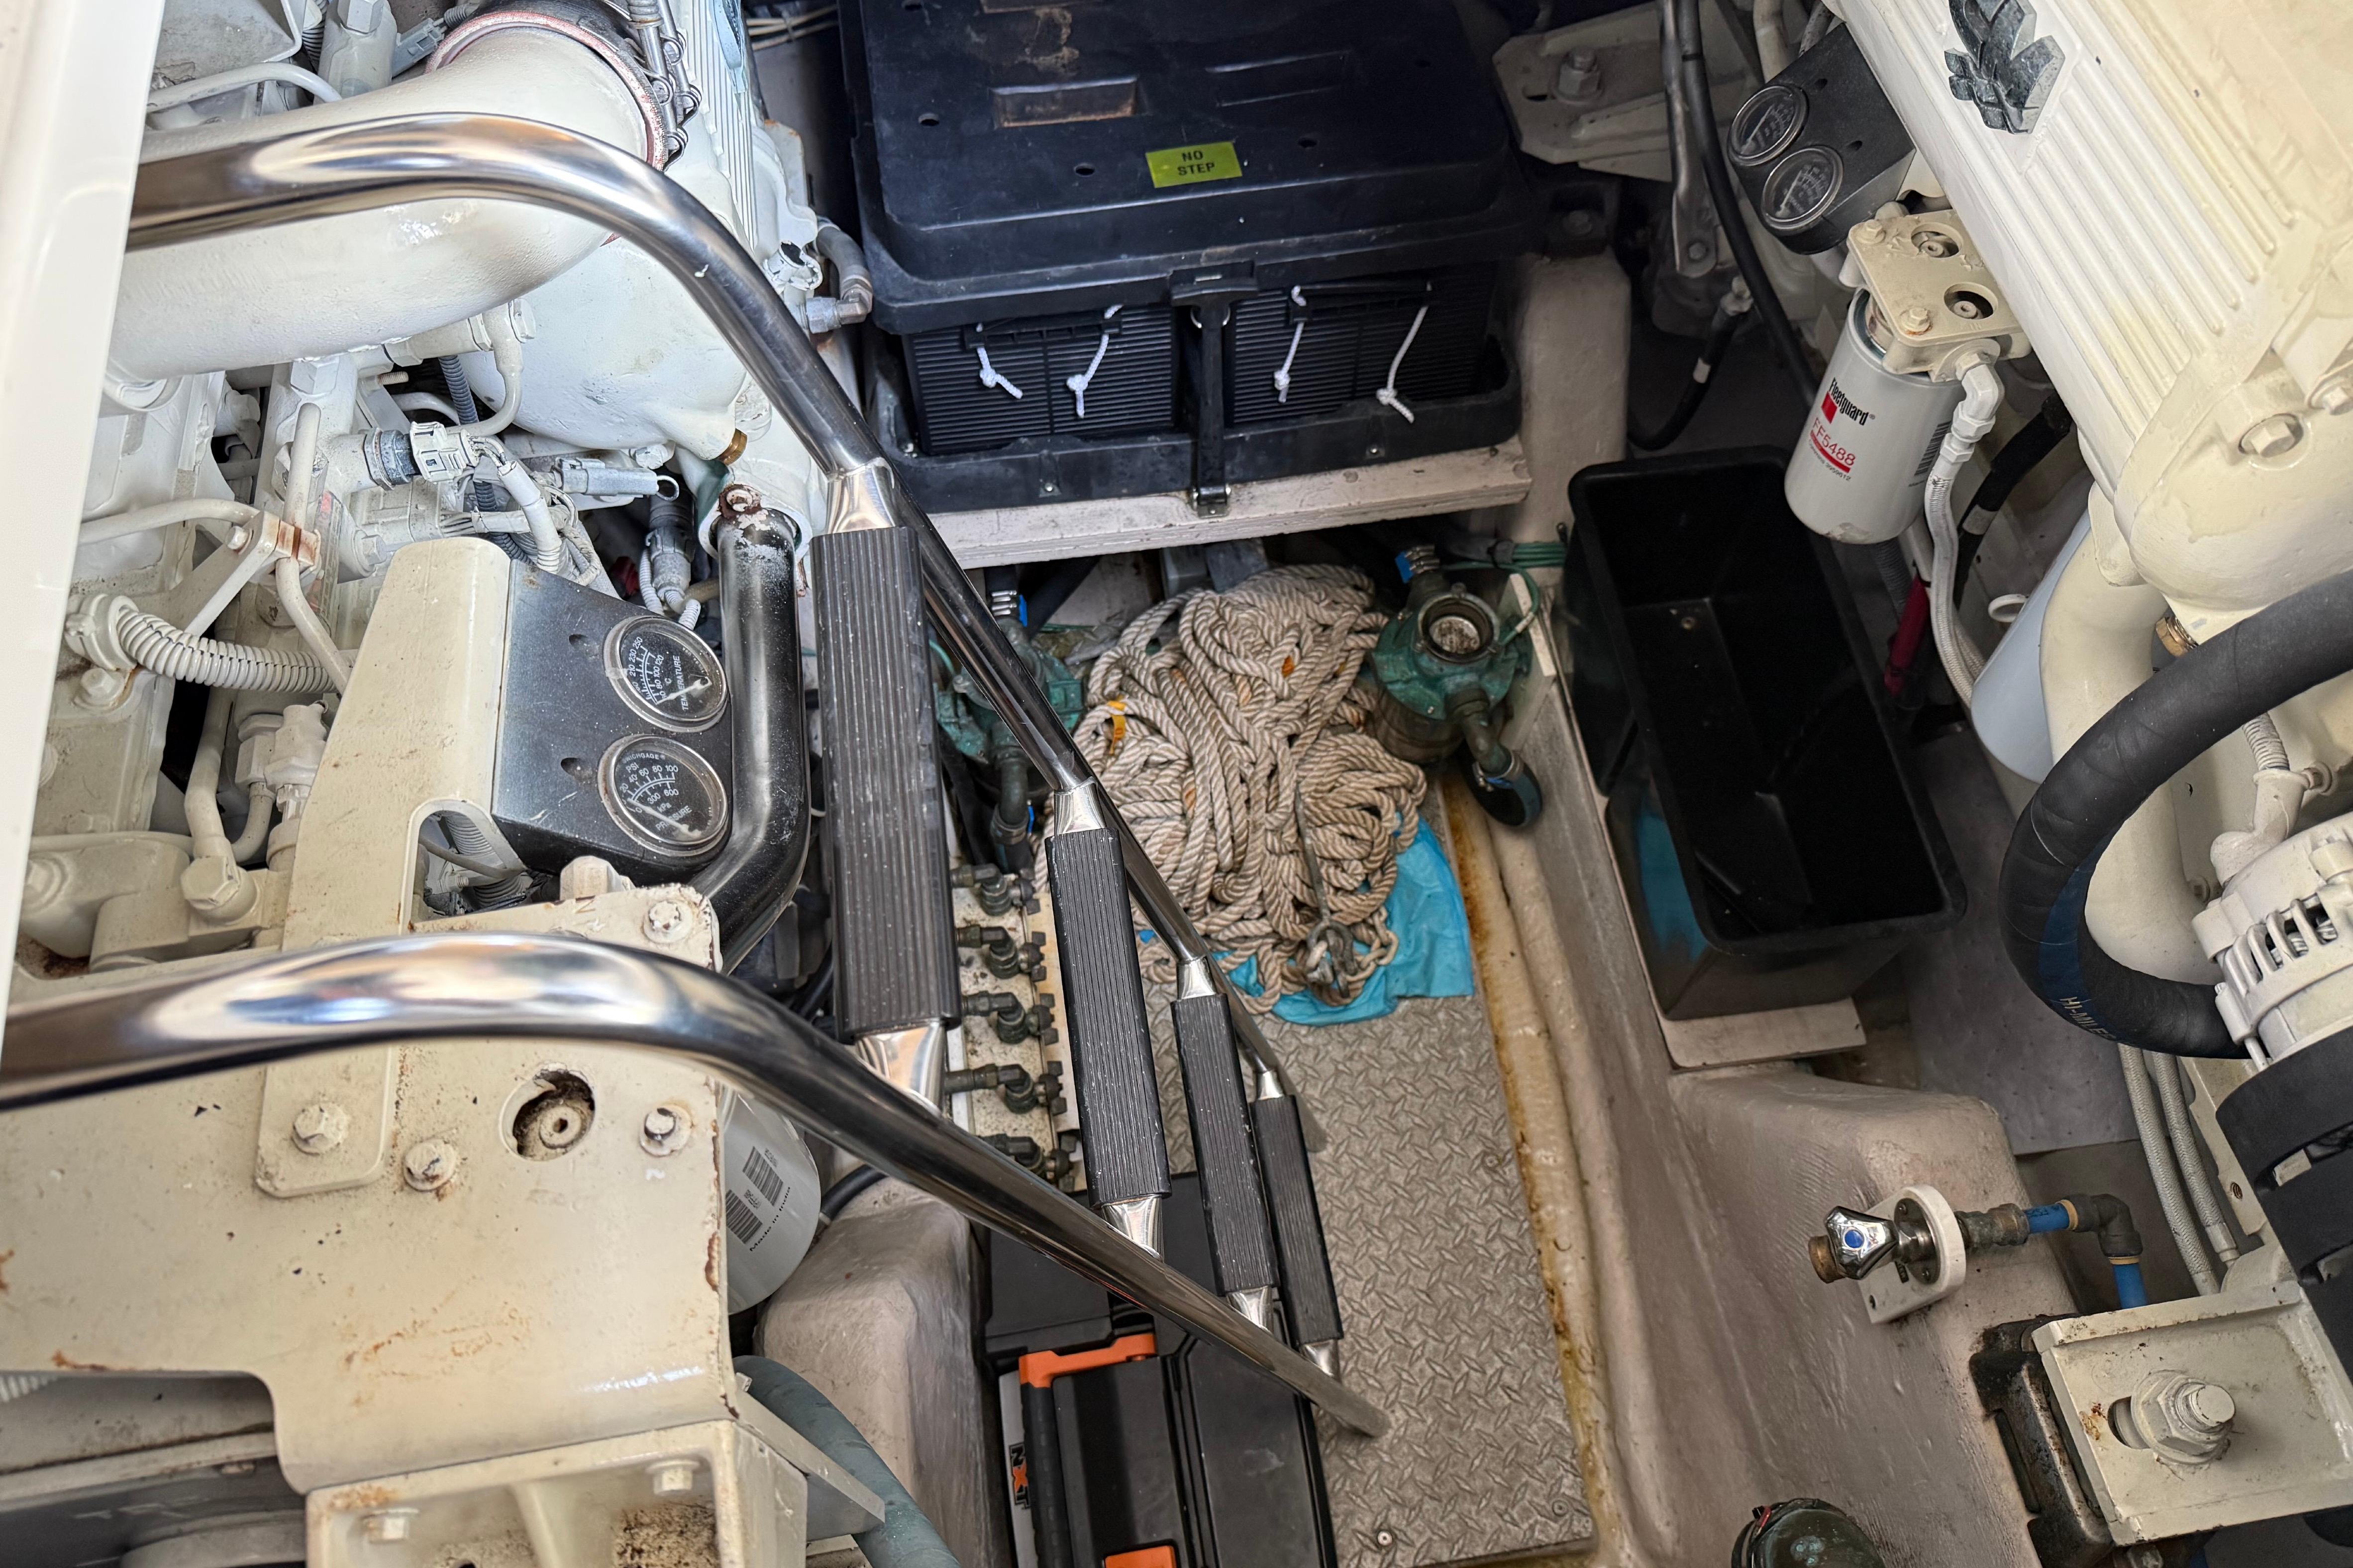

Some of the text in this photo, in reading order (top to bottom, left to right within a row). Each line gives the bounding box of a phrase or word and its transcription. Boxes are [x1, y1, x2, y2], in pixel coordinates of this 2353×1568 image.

[1182, 150, 1204, 162] NO
[1177, 162, 1215, 176] STEP
[1813, 417, 1856, 466] FF5488
[633, 637, 643, 650] 250
[655, 655, 664, 666] 120
[654, 680, 663, 689] 80
[673, 655, 689, 711] TEMERATURE
[626, 762, 639, 773] PSI
[619, 783, 629, 793] 20
[628, 774, 638, 783] 40
[639, 768, 649, 777] 60
[647, 792, 661, 804] 300
[657, 803, 672, 813] kPa
[749, 1186, 791, 1252] Made in India
[1009, 1442, 1031, 1509] NXT
